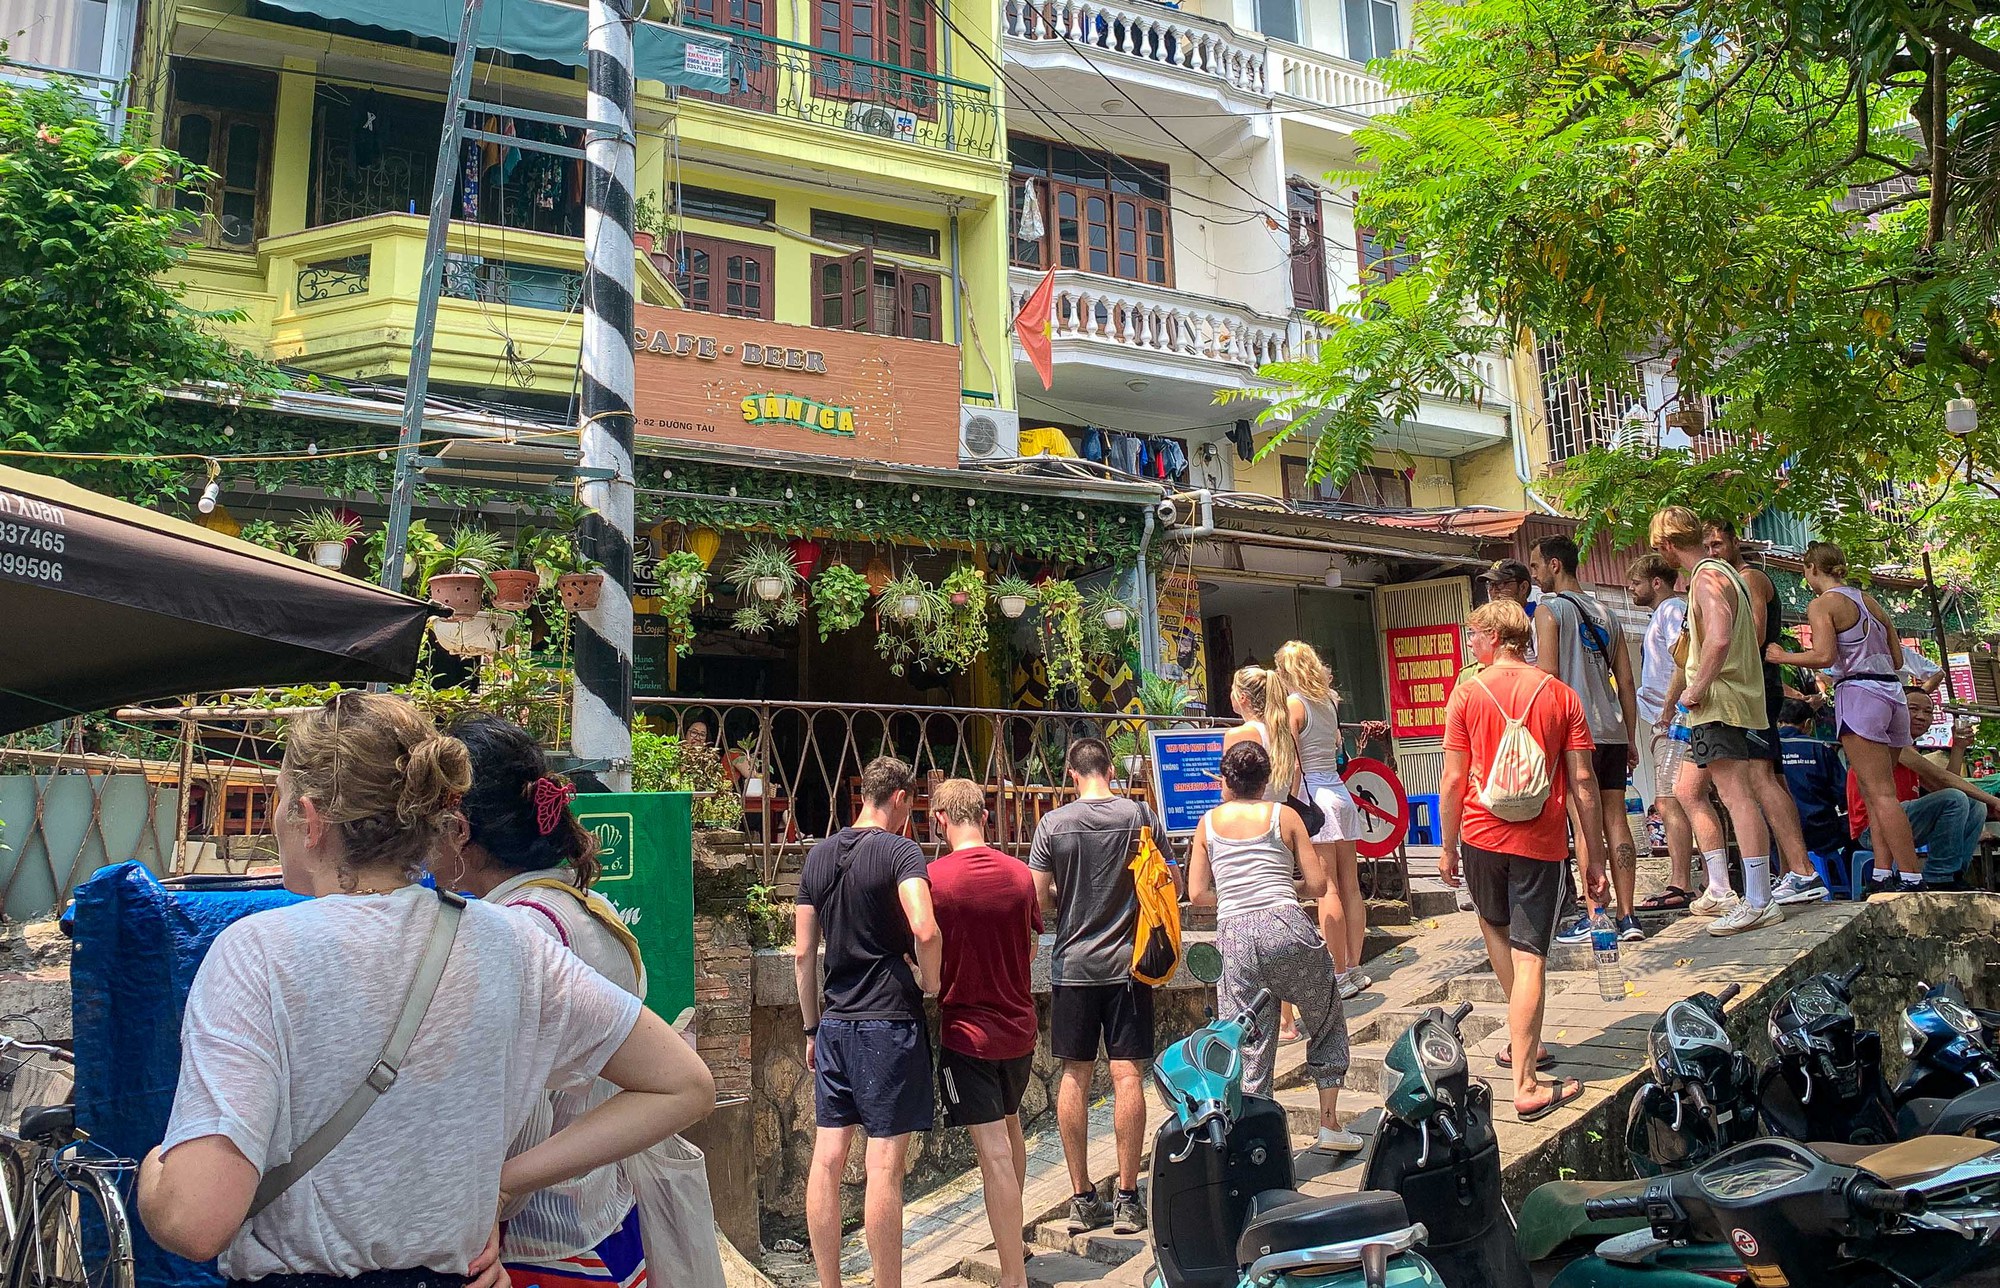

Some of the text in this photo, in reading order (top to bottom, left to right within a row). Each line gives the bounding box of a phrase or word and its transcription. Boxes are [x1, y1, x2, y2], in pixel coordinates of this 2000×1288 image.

[742, 342, 827, 374] BEER
[643, 418, 655, 427] 62
[0, 552, 63, 582] 99596
[1393, 632, 1454, 658] GERMAN DRAFT BEER
[1397, 658, 1454, 680] TEN THOUSAND VND
[1413, 684, 1430, 703] BEER
[1430, 683, 1445, 702] MUG
[1397, 708, 1414, 727] TAKE
[1414, 707, 1433, 727] AWAY
[1167, 806, 1184, 814] DO NOT
